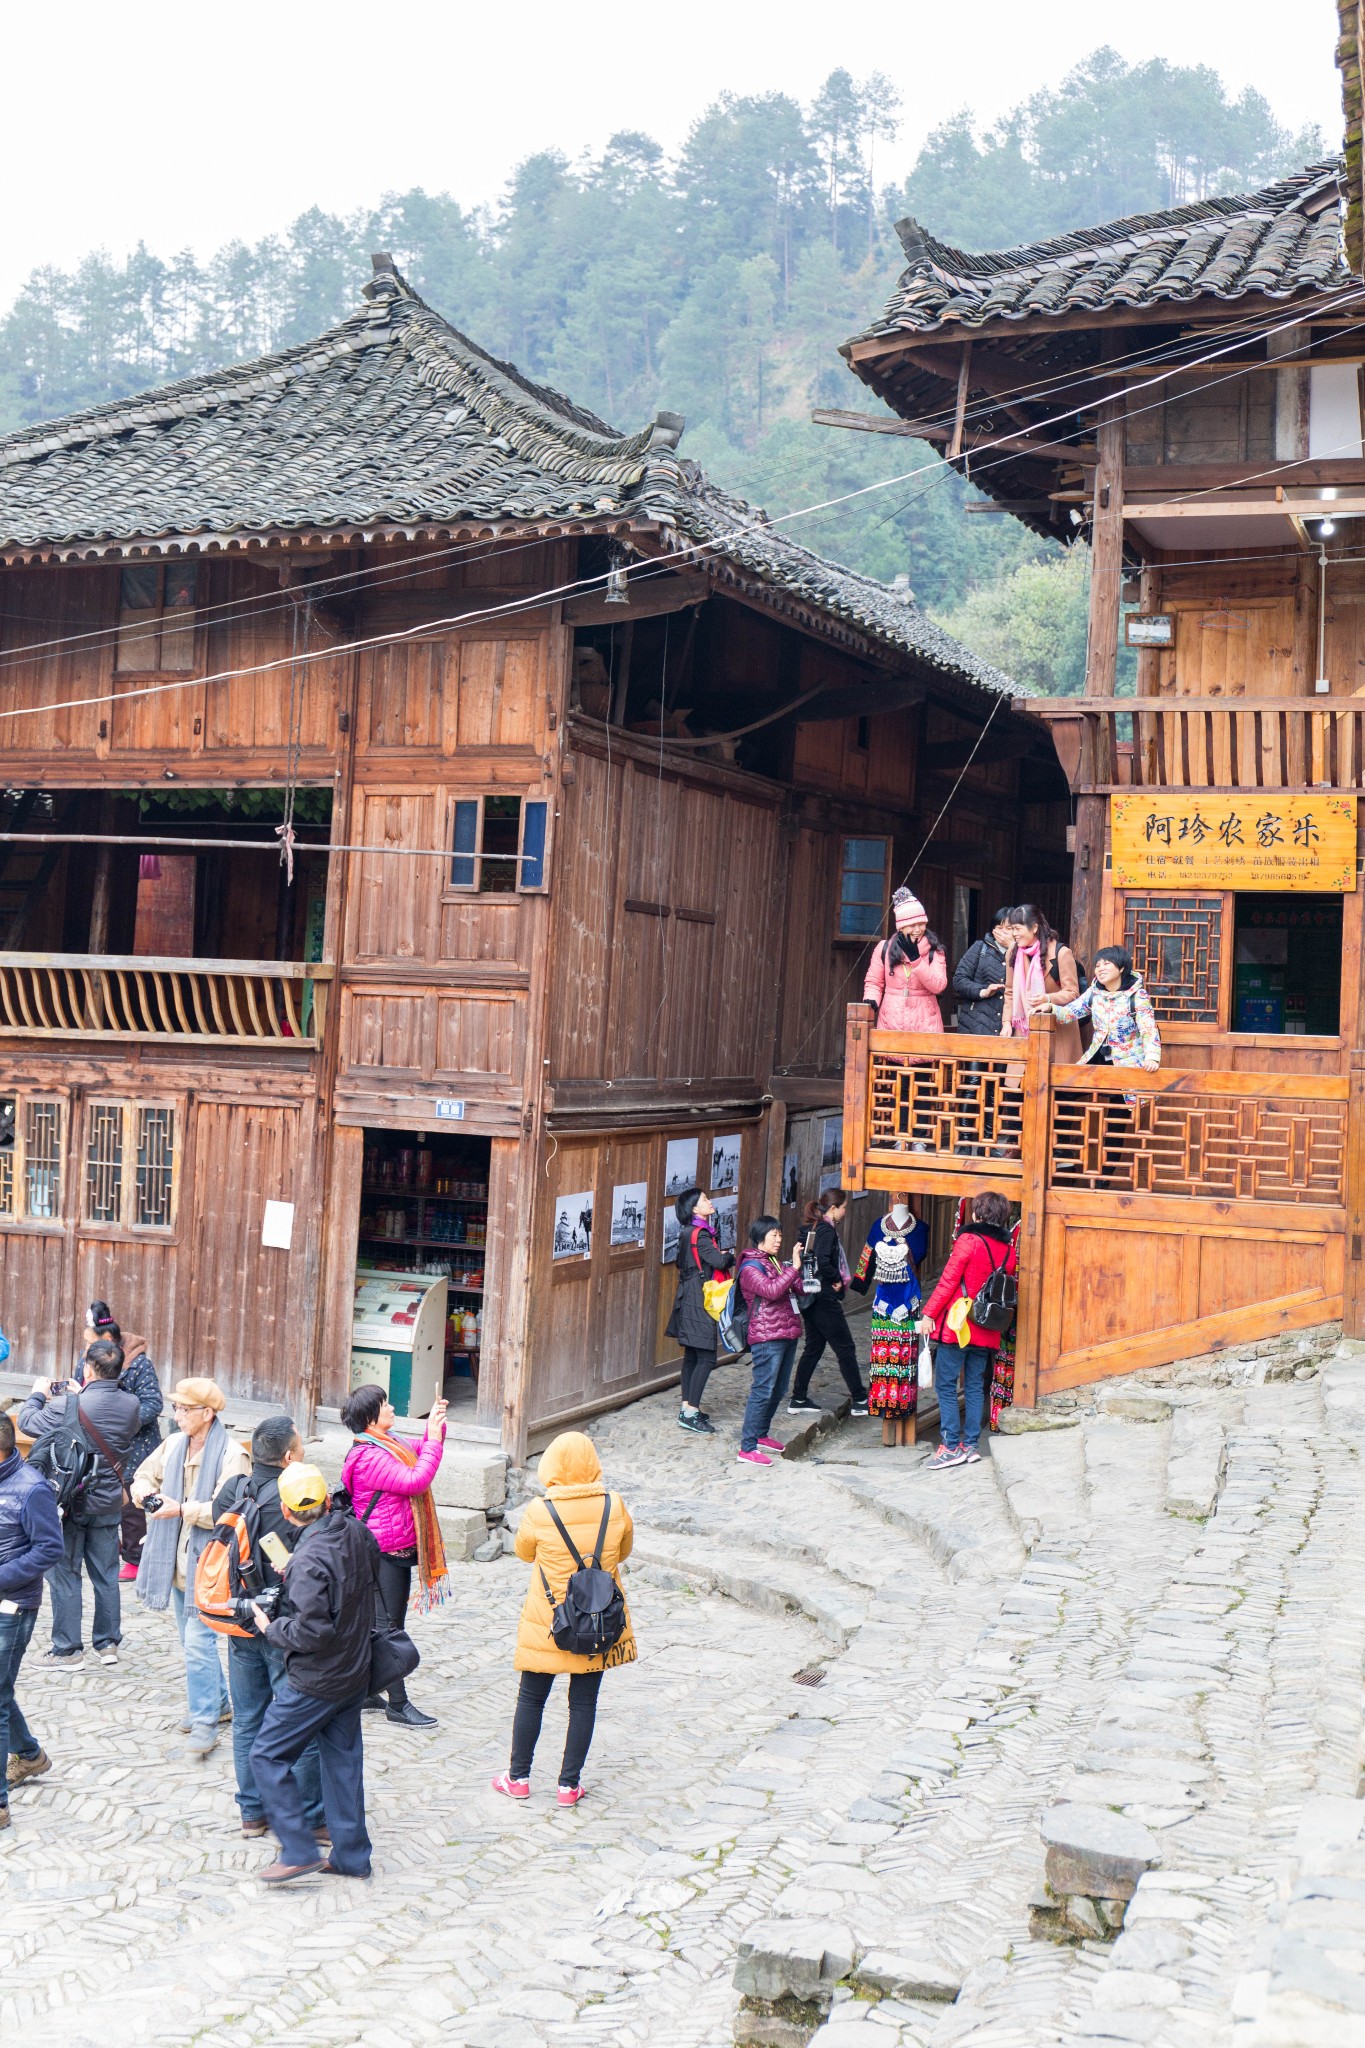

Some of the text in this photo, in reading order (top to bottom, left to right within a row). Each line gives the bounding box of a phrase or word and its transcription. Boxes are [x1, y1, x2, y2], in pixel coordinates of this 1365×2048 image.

[1146, 811, 1320, 848] 阿珍农家乐
[1146, 855, 1167, 866] 住宿
[1173, 855, 1194, 866] 就餐
[1202, 856, 1246, 867] 工艺刺绣
